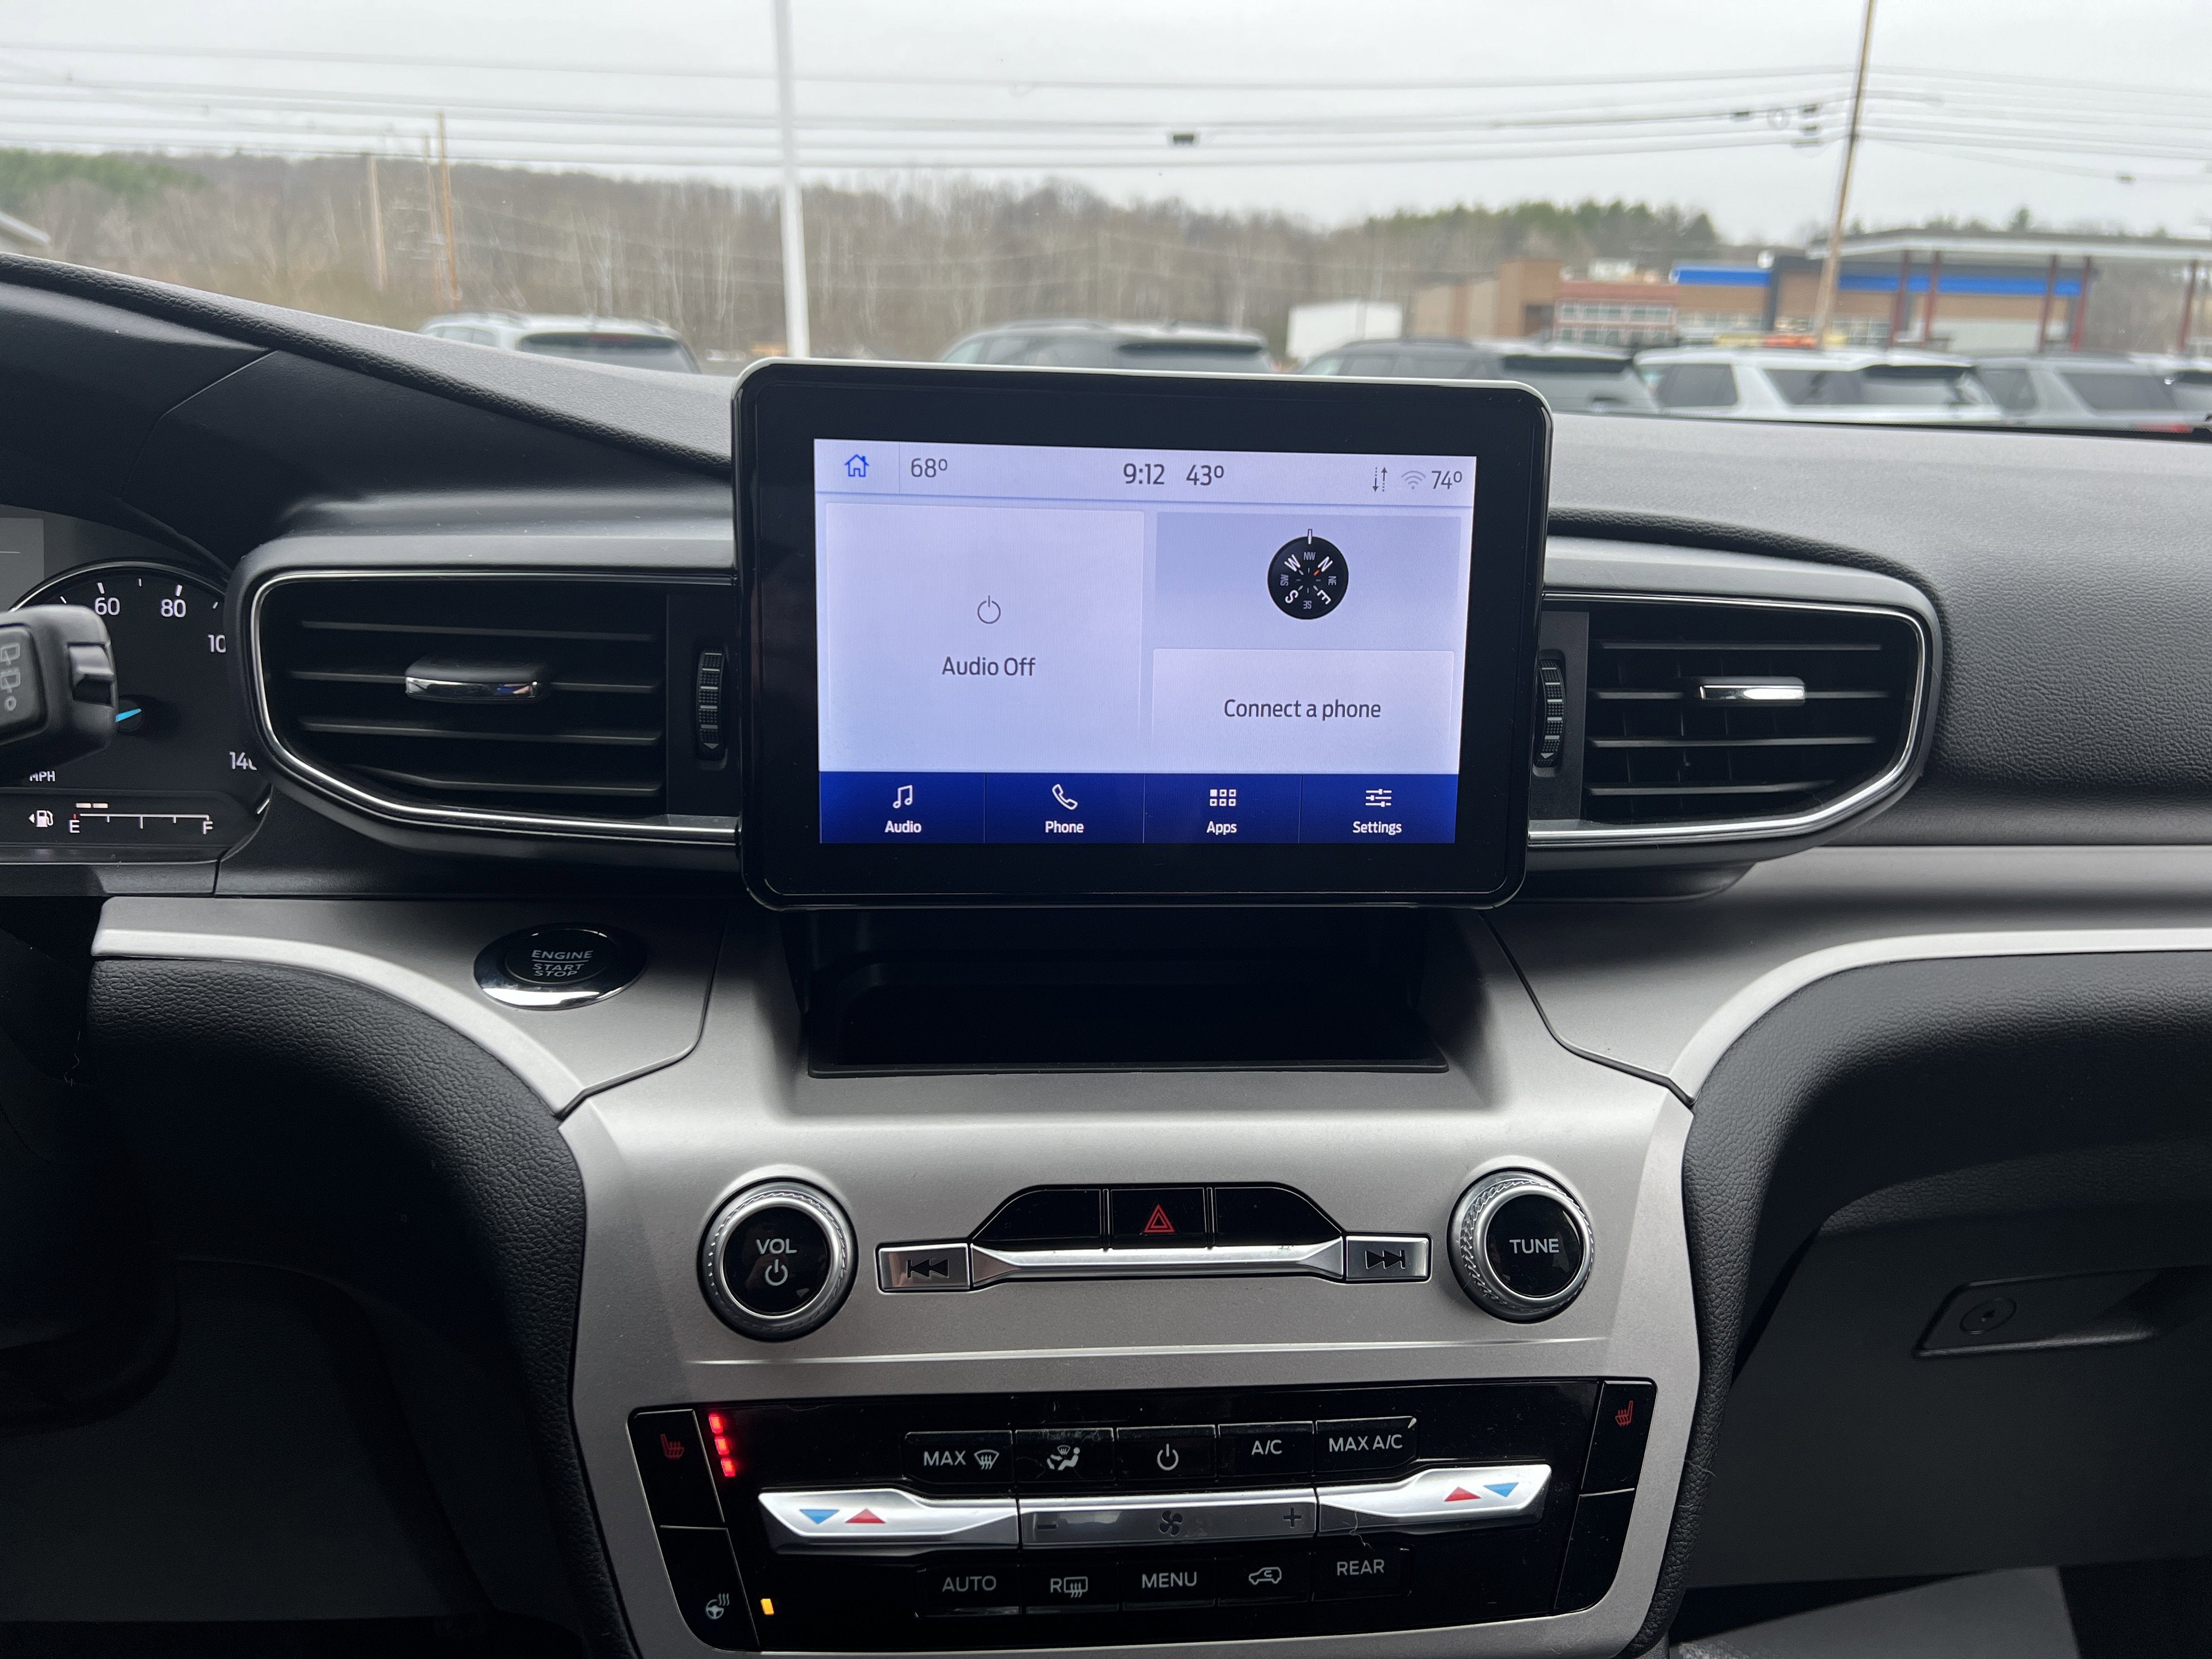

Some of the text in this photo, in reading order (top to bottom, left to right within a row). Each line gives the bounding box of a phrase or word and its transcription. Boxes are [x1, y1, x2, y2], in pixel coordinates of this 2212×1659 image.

[1123, 463, 1165, 485] 9:12
[1284, 554, 1301, 572] W
[1304, 551, 1316, 561] NW
[1318, 556, 1333, 572] N
[1280, 574, 1289, 586] SW
[1328, 575, 1337, 585] NE
[1285, 589, 1299, 603] S
[1317, 590, 1332, 605] E
[94, 597, 120, 616] 60
[161, 599, 186, 618] 80
[1303, 600, 1312, 610] SE
[208, 634, 227, 653] 10
[942, 656, 1036, 676] Audio Off
[1224, 699, 1381, 721] Connect a phone
[69, 819, 80, 833] E
[202, 821, 213, 835] F
[884, 820, 922, 833] Audio
[1045, 820, 1084, 833] Phone
[1206, 821, 1237, 836] Apps
[1352, 821, 1402, 836] Settings
[531, 950, 594, 959] ENGINE
[756, 1238, 797, 1255] VOL
[1509, 1238, 1560, 1254] TUNE
[1251, 1439, 1282, 1455] A/C
[1329, 1434, 1403, 1452] MAX A/C
[923, 1450, 966, 1466] MAX
[1336, 1559, 1385, 1576] REAR
[942, 1575, 997, 1592] AUTO
[1142, 1571, 1197, 1589] MENU
